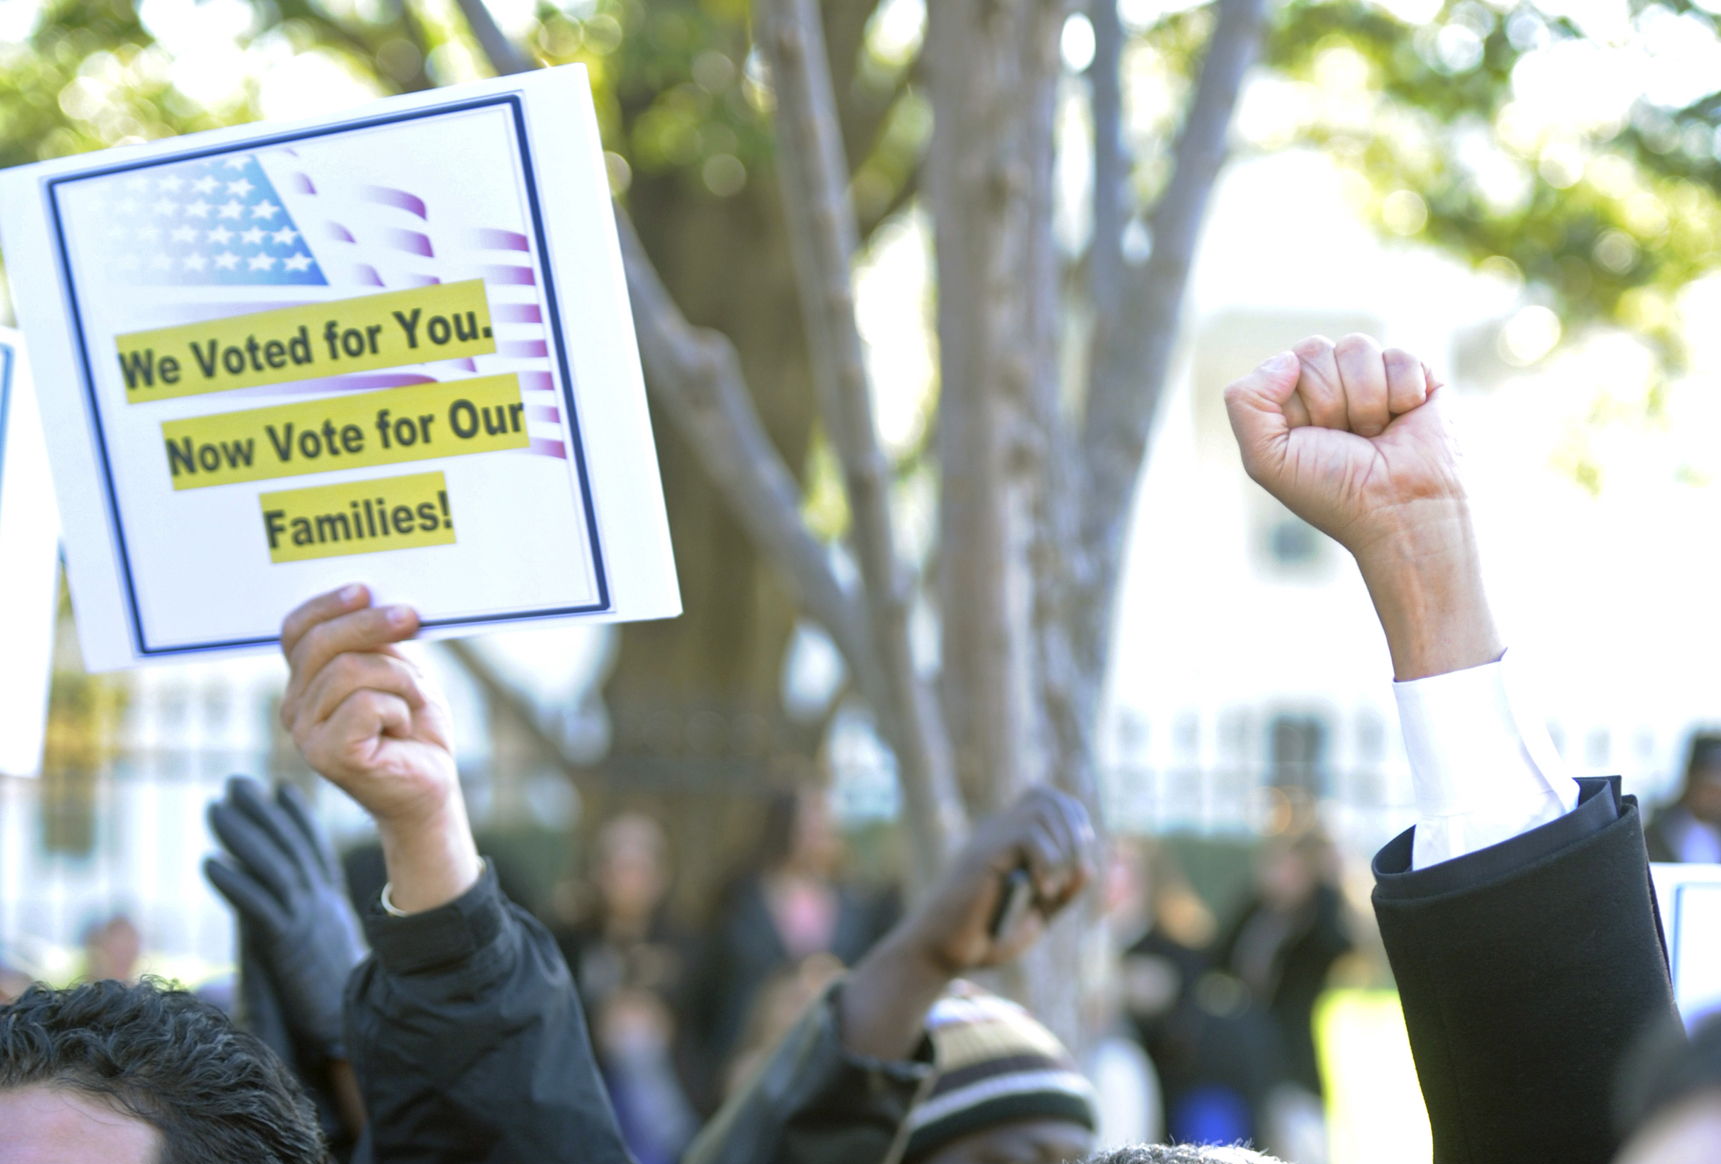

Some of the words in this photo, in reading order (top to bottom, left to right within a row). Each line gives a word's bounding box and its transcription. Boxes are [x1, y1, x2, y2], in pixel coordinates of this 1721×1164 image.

[119, 350, 180, 390] We
[190, 326, 312, 377] Voted
[323, 320, 382, 361] for
[393, 308, 493, 349] You.
[166, 435, 255, 476] Now
[266, 419, 365, 463] Vote
[377, 409, 434, 450] for
[448, 399, 525, 438] Our
[263, 490, 453, 549] Families!
